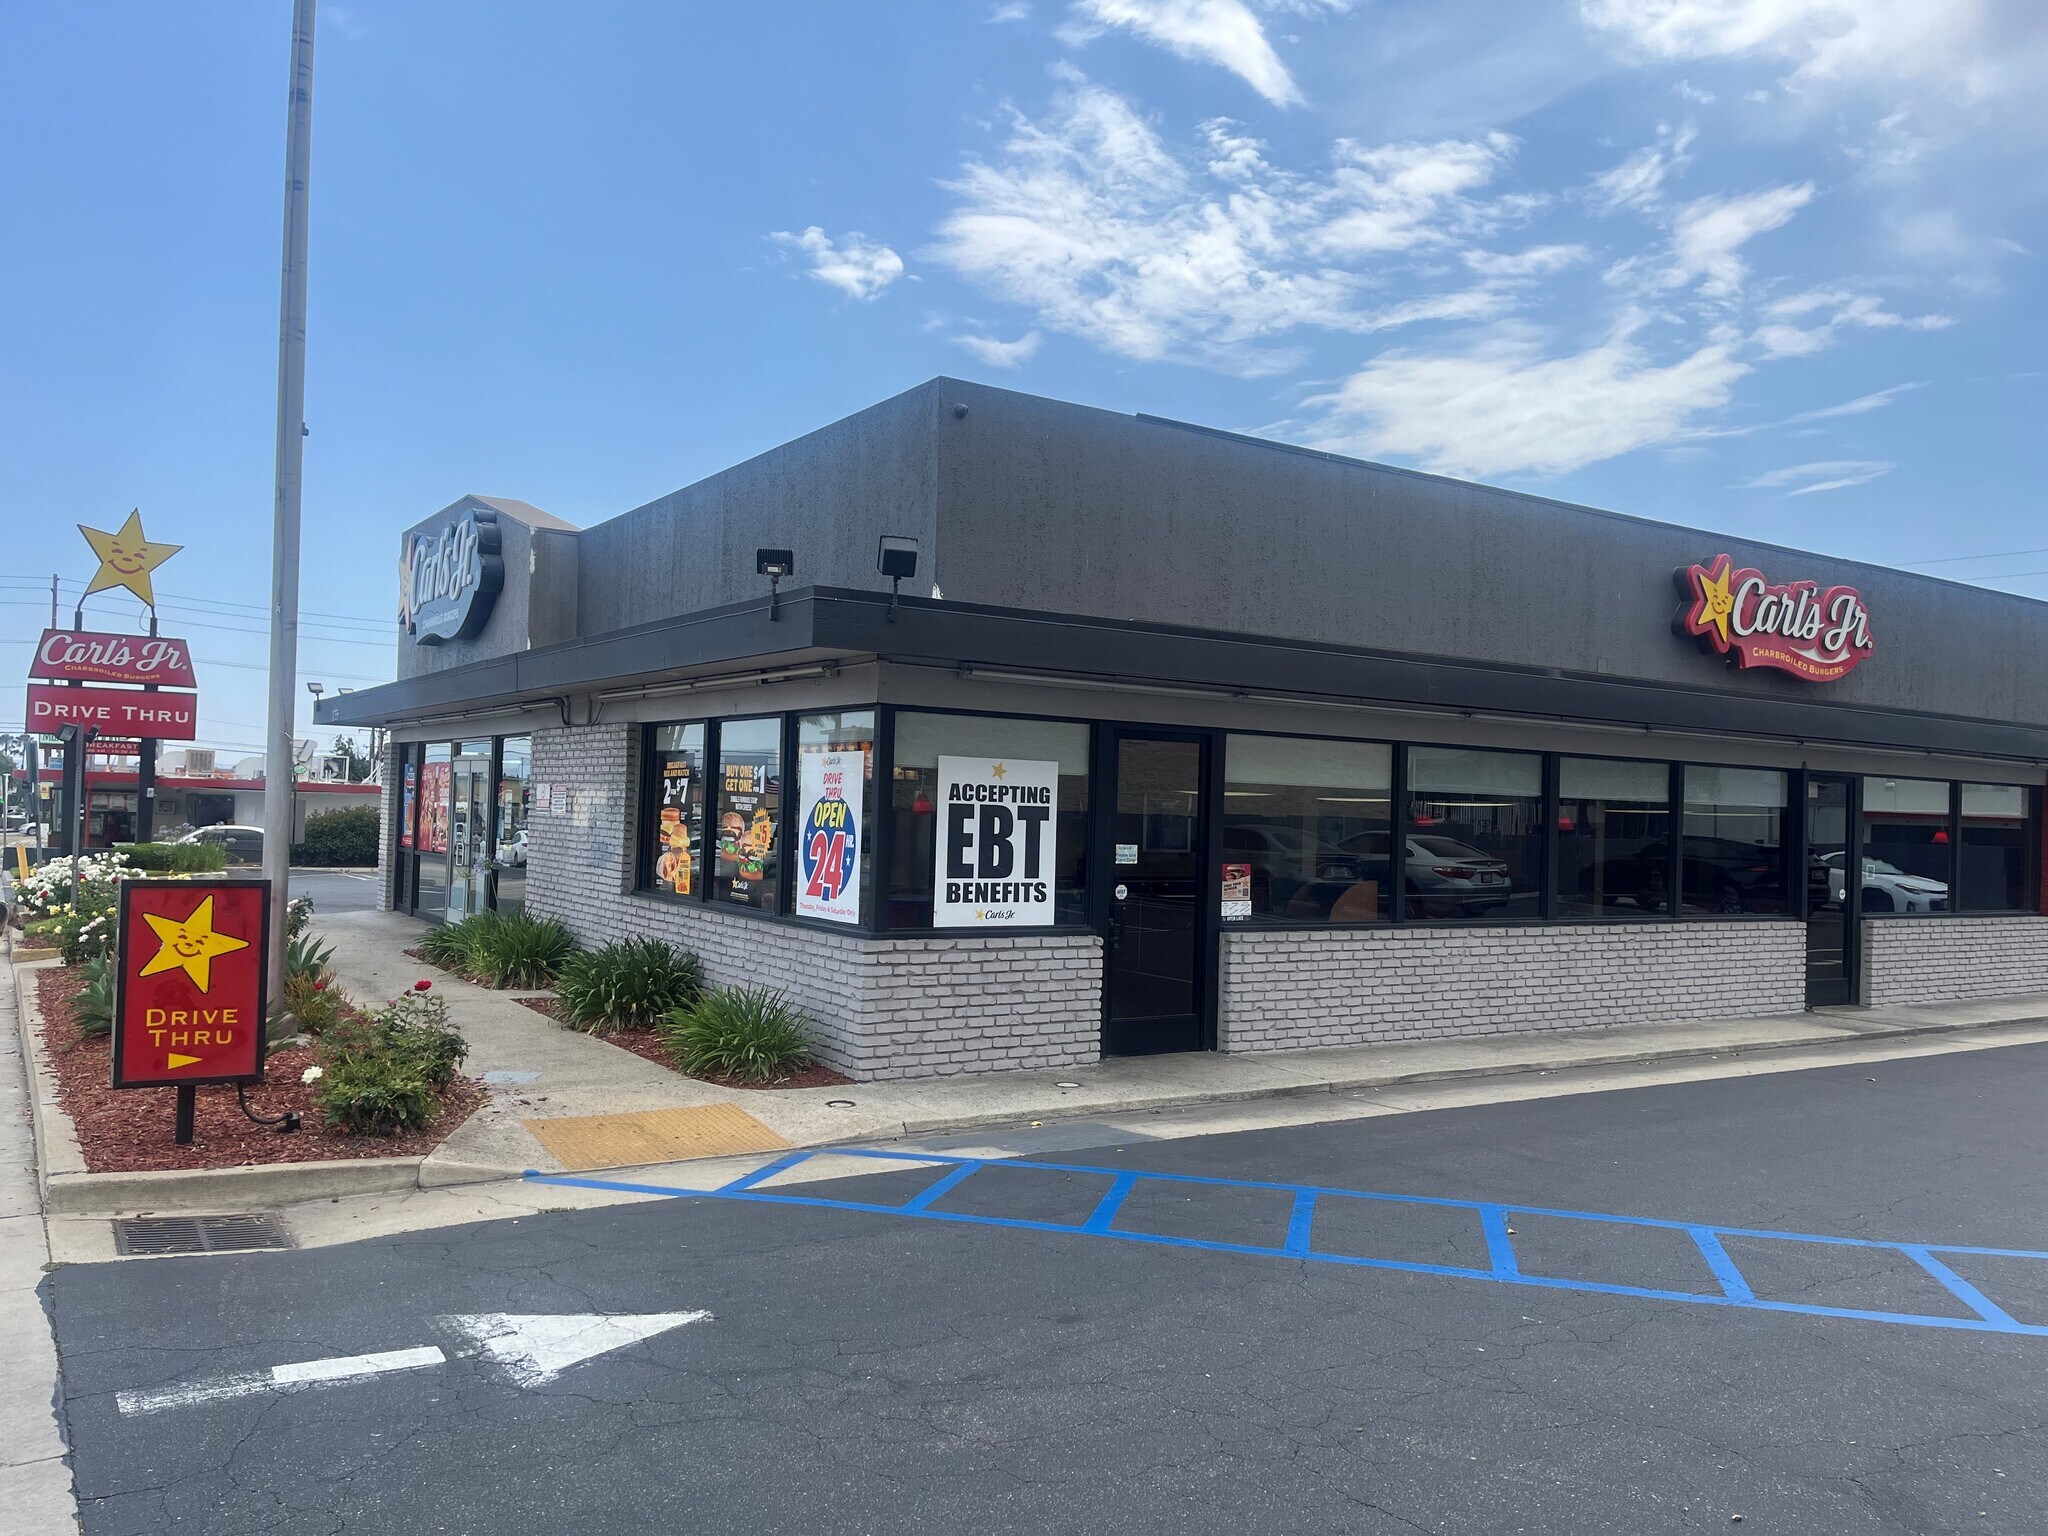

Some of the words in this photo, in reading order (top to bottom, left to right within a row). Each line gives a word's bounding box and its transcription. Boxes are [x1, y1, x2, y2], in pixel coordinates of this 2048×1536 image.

[410, 528, 452, 615] Carl's
[1732, 577, 1825, 640] Carl's
[40, 634, 135, 666] Carl's
[1752, 646, 1808, 672] CHARBROILED
[1808, 664, 1844, 676] BURGERS
[64, 664, 122, 679] CHARBROILED
[34, 701, 111, 719] DRIVE
[121, 705, 190, 723] THRU
[726, 765, 740, 778] BUY
[740, 765, 753, 778] ONE
[753, 764, 766, 793] $1
[823, 773, 843, 785] DRIVE
[663, 778, 671, 804] 2
[676, 778, 689, 804] $7
[726, 779, 739, 792] GET
[738, 779, 753, 793] ONE
[825, 787, 843, 799] THRU
[948, 783, 1051, 804] ACCEPTING
[814, 801, 847, 829] OPEN
[946, 803, 1050, 879] EBT
[806, 830, 846, 900] 24
[946, 882, 1047, 904] BENEFITS
[146, 1008, 238, 1027] DRIVE
[148, 1028, 233, 1047] THRU
